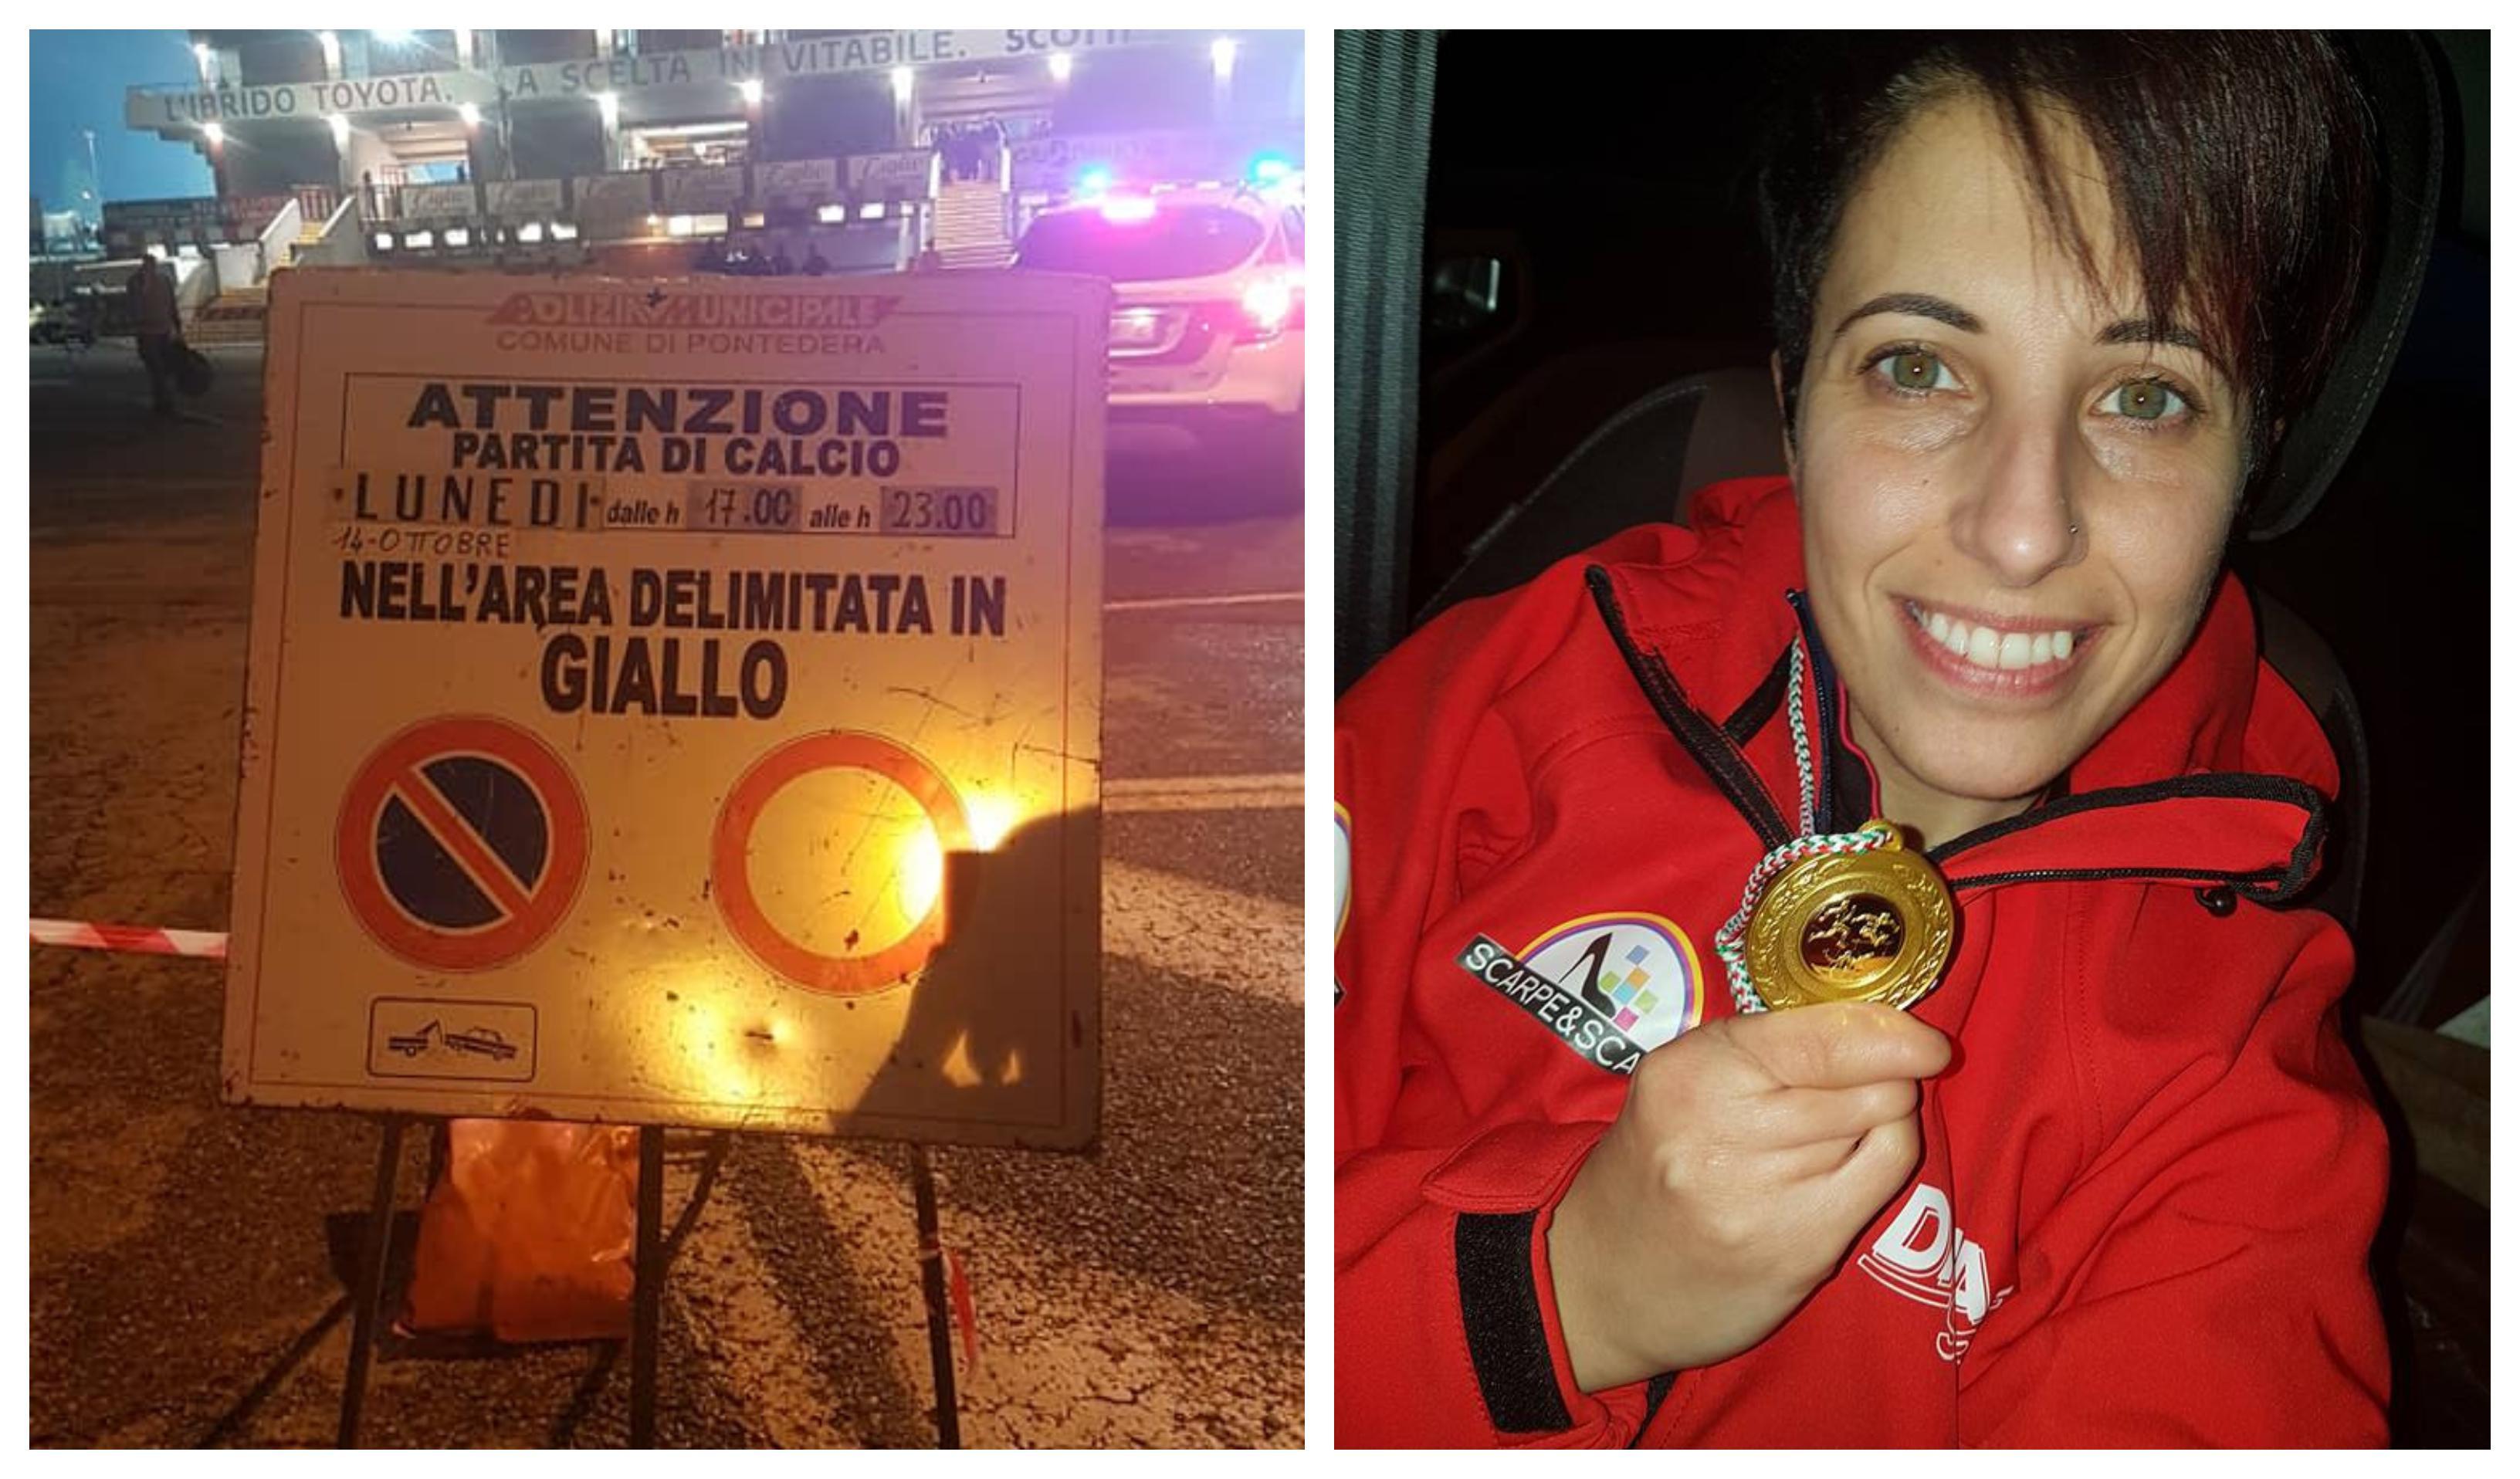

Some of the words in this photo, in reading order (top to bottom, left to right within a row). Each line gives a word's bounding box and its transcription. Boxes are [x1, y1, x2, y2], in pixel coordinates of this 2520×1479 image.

[312, 76, 453, 110] TOYOTA.
[561, 53, 690, 94] SCELTA
[717, 30, 966, 76] INVITABILE.
[496, 330, 631, 354] COMUNE
[647, 332, 675, 354] DI
[688, 333, 886, 355] PONTEDERA
[407, 382, 950, 438] ATTENZIONE
[453, 431, 645, 474] PARTITA
[662, 438, 707, 475] DI
[724, 438, 900, 478] CALCIO
[606, 498, 659, 525] dalle
[666, 502, 680, 524] h
[704, 487, 794, 527] 17.00
[809, 505, 852, 529] alle
[857, 506, 871, 529] h
[891, 490, 987, 530] 23.00
[340, 560, 614, 627] NELL'AREA
[629, 568, 934, 635] DELIMITATA
[950, 576, 1007, 637] IN
[541, 631, 789, 720] GIALLO
